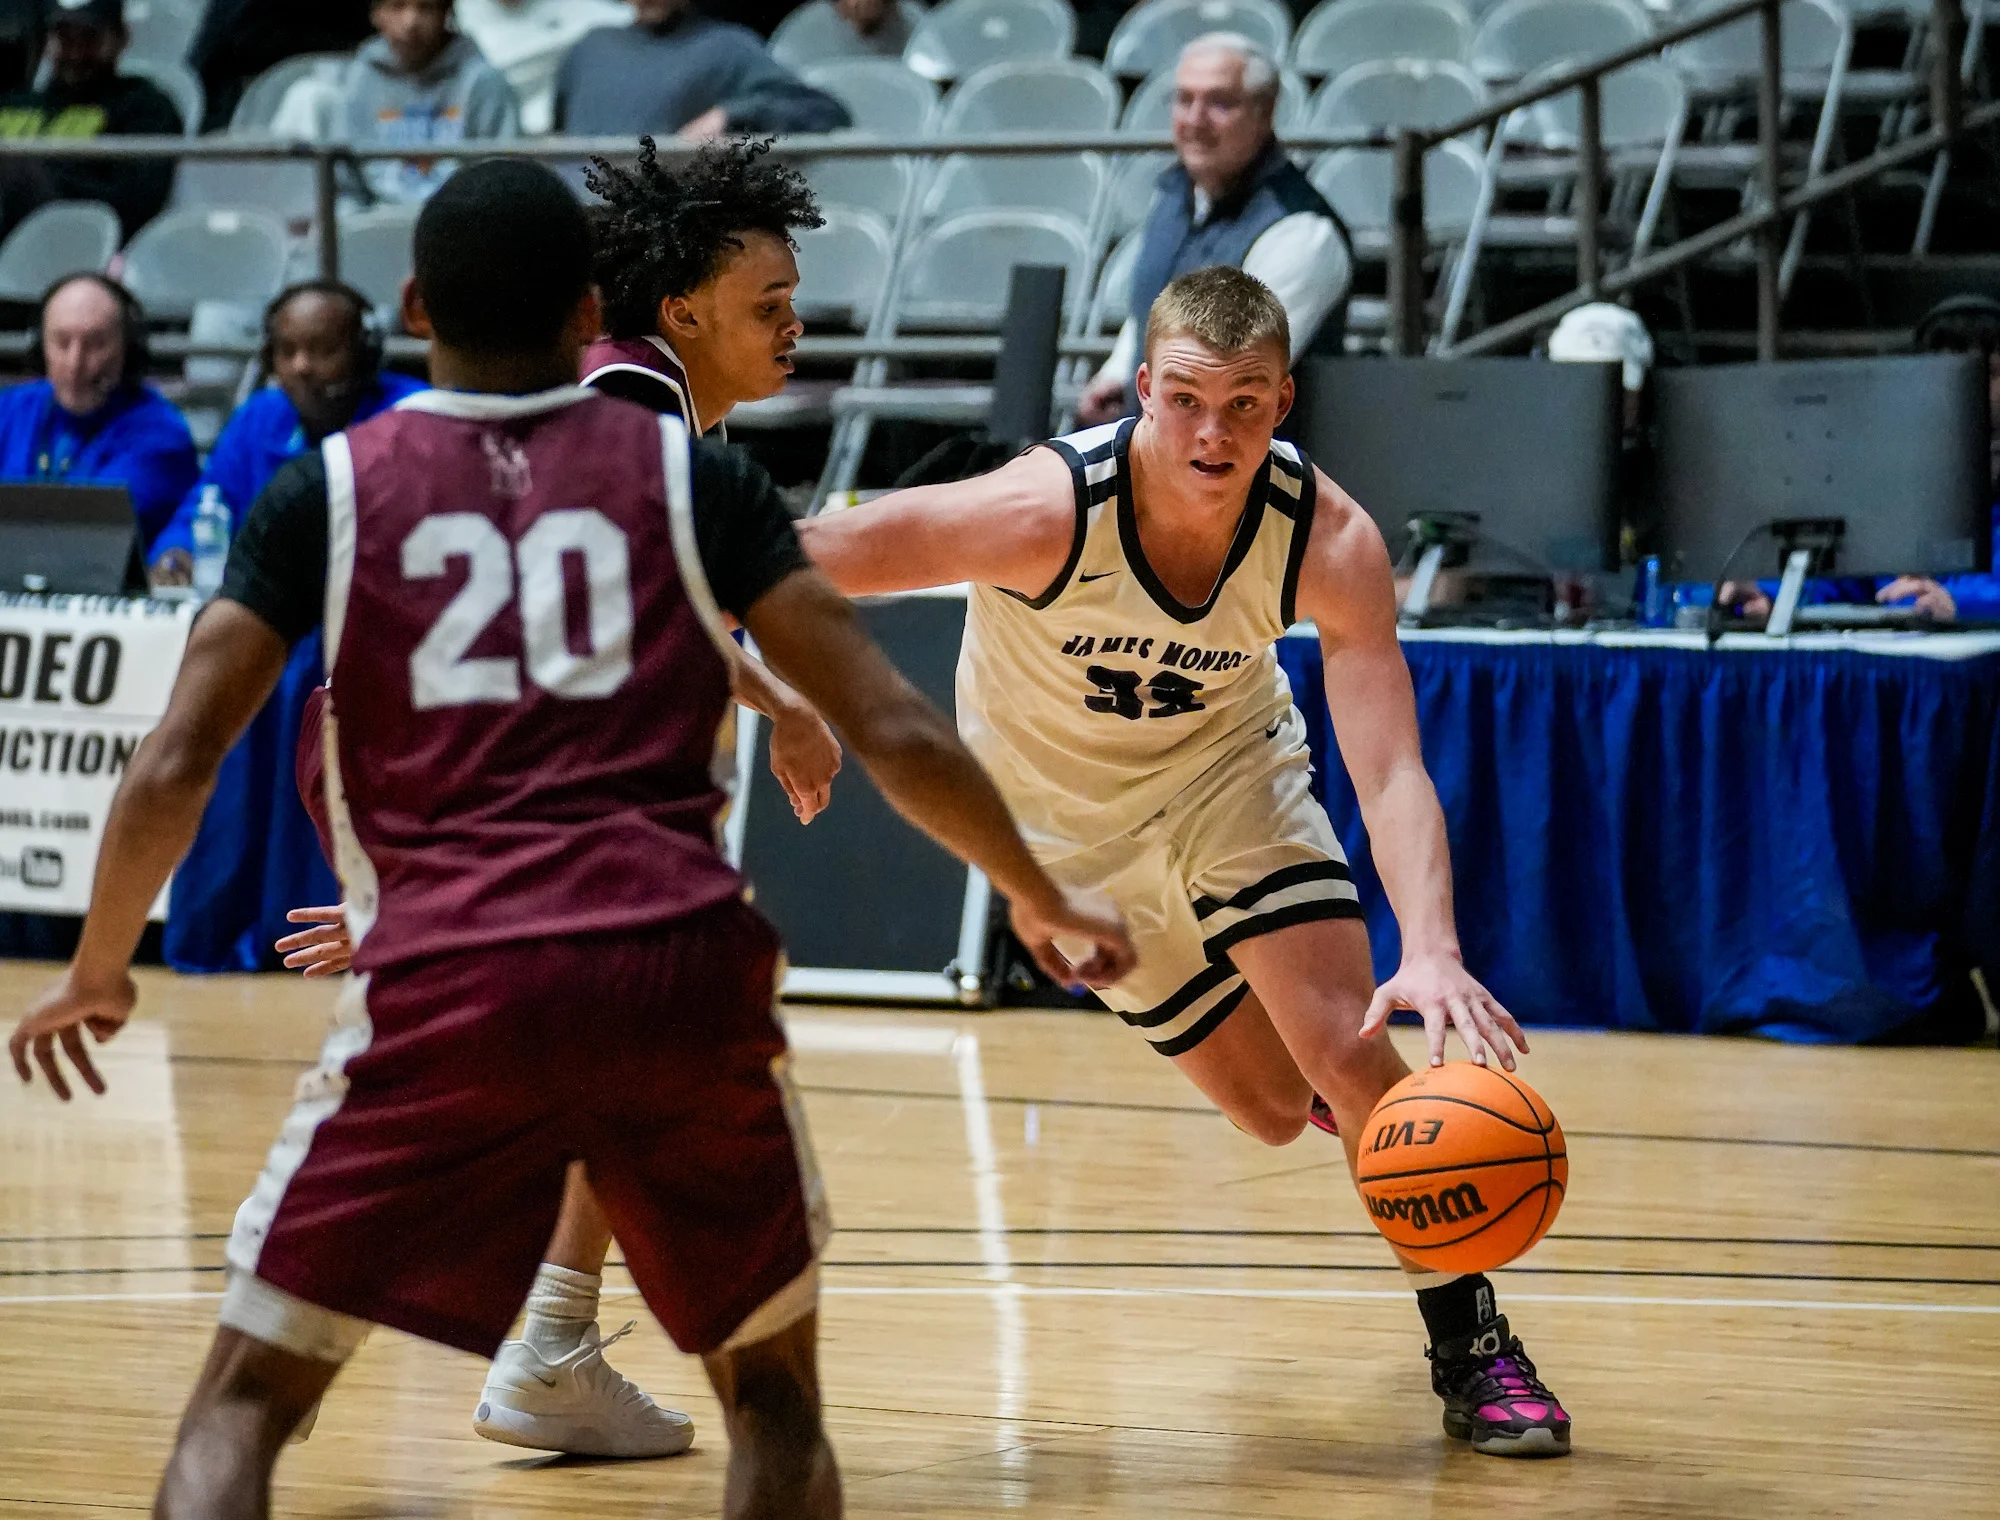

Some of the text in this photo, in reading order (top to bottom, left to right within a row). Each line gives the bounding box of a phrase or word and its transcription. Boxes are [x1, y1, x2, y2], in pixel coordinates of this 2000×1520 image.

[402, 507, 634, 712] 20
[0, 633, 122, 705] DEO
[1061, 635, 1155, 657] JAMES
[1375, 1119, 1444, 1152] EVO
[1364, 1182, 1489, 1231] Wilson
